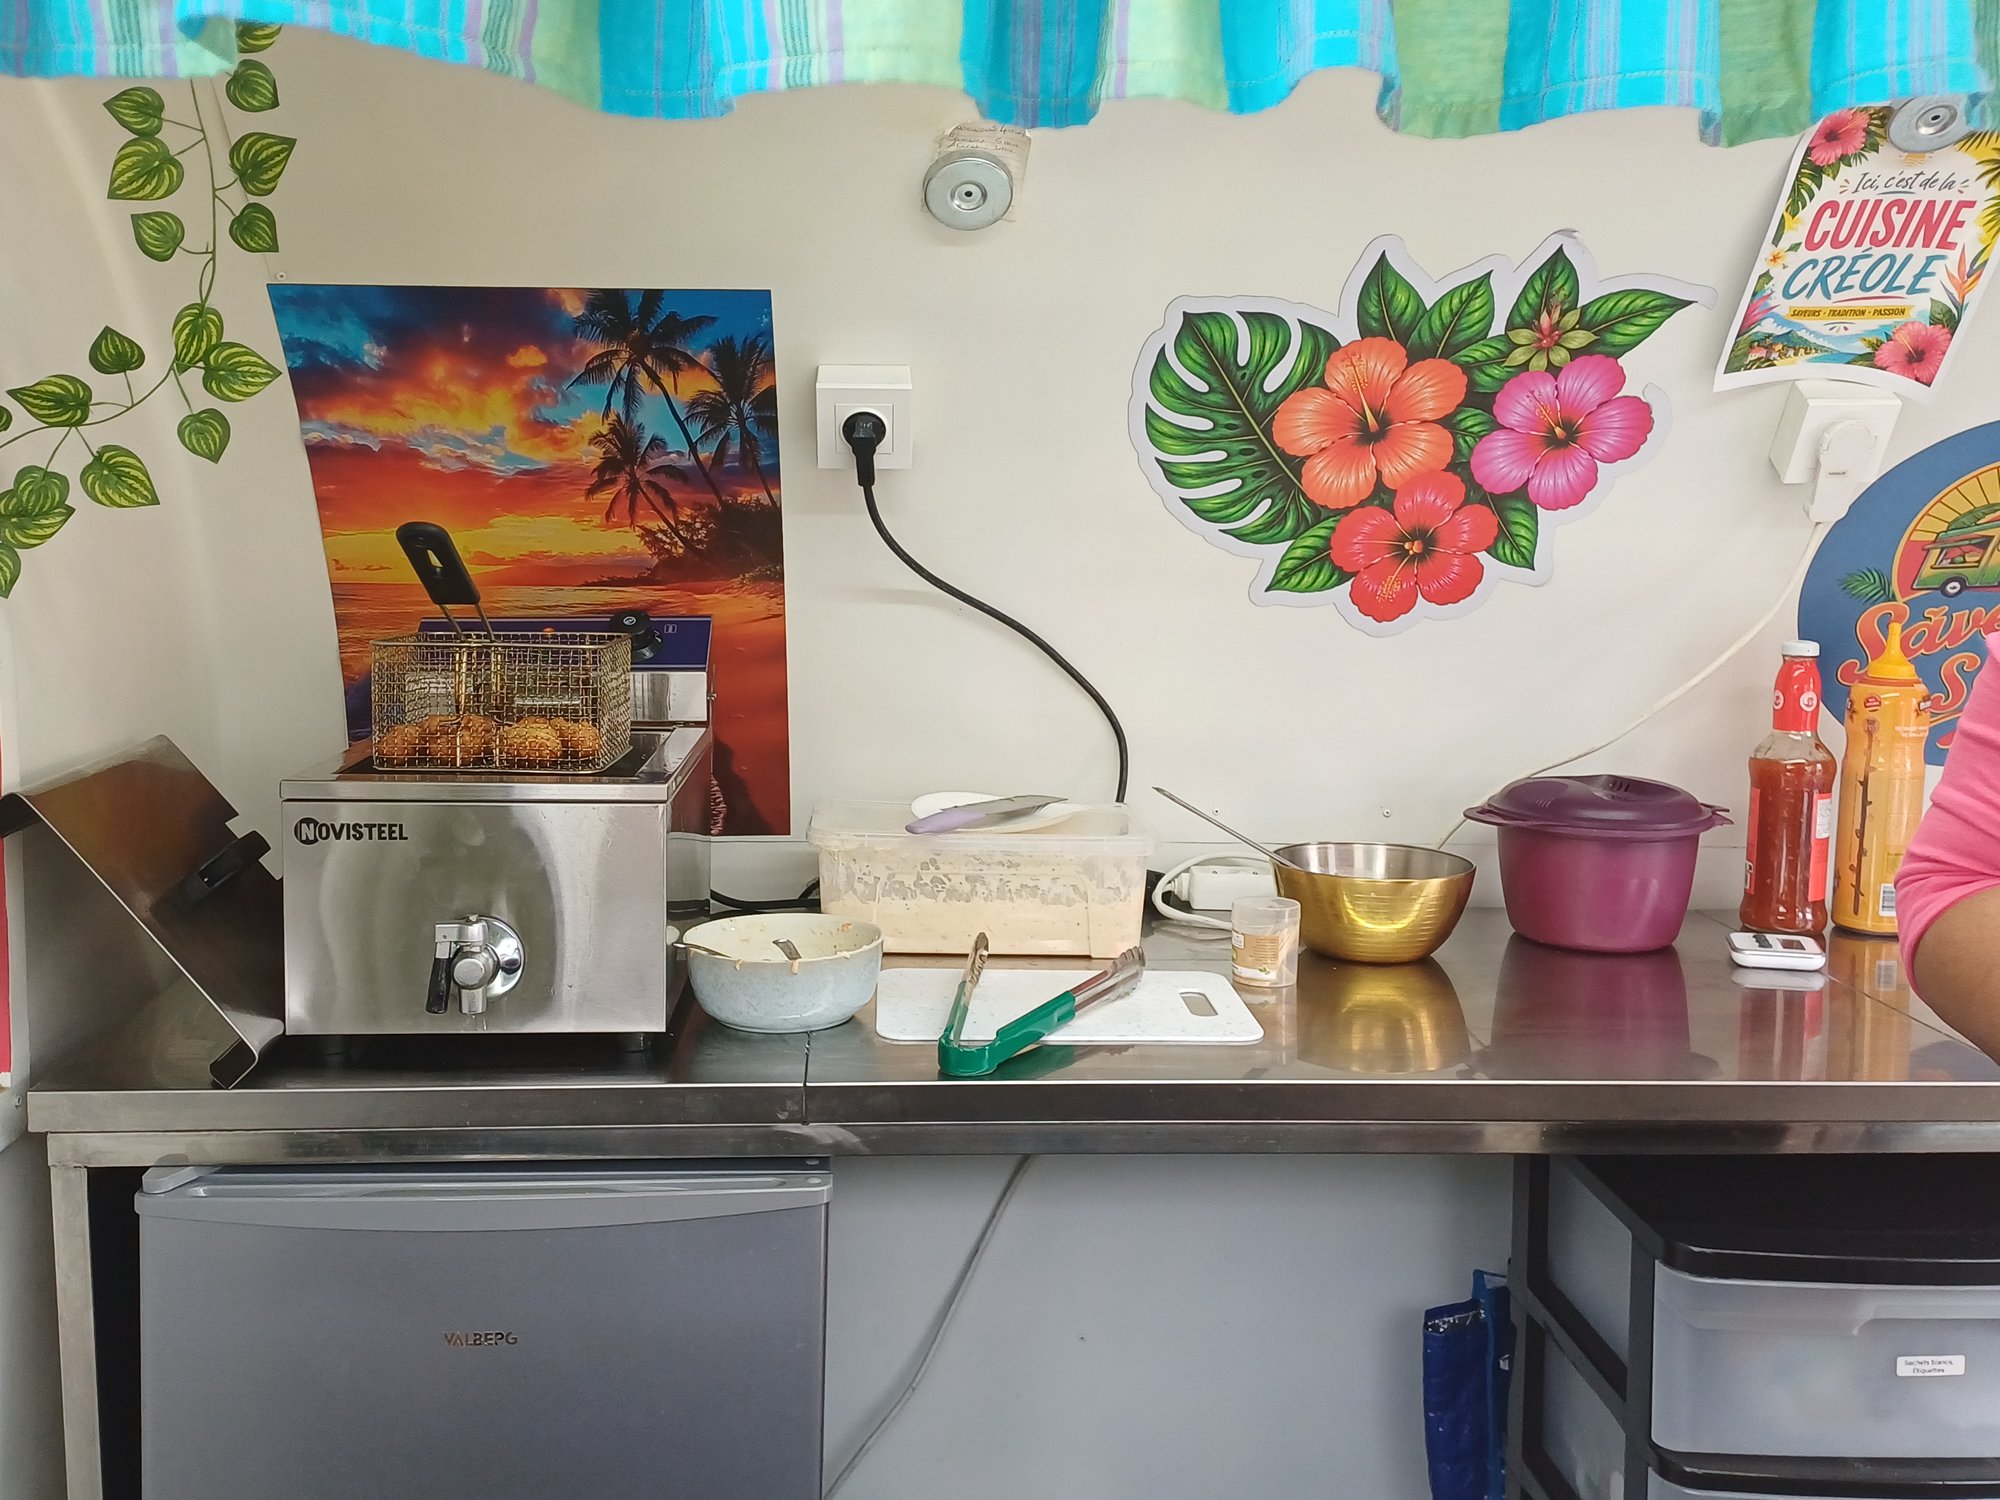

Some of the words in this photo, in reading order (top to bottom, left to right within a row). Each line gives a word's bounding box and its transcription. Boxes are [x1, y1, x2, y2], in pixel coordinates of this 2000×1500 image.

[1851, 171, 1881, 194] Ici,
[1884, 170, 1925, 190] c'est
[1918, 170, 1940, 190] de
[1937, 171, 1957, 191] la
[1803, 198, 1977, 251] CUISINE
[1781, 246, 1949, 300] CRÉOLE
[1790, 308, 1822, 317] SAVEURS
[1827, 308, 1867, 317] TRADITION
[1872, 307, 1906, 316] PASSION
[297, 819, 409, 843] NOVISTEEL
